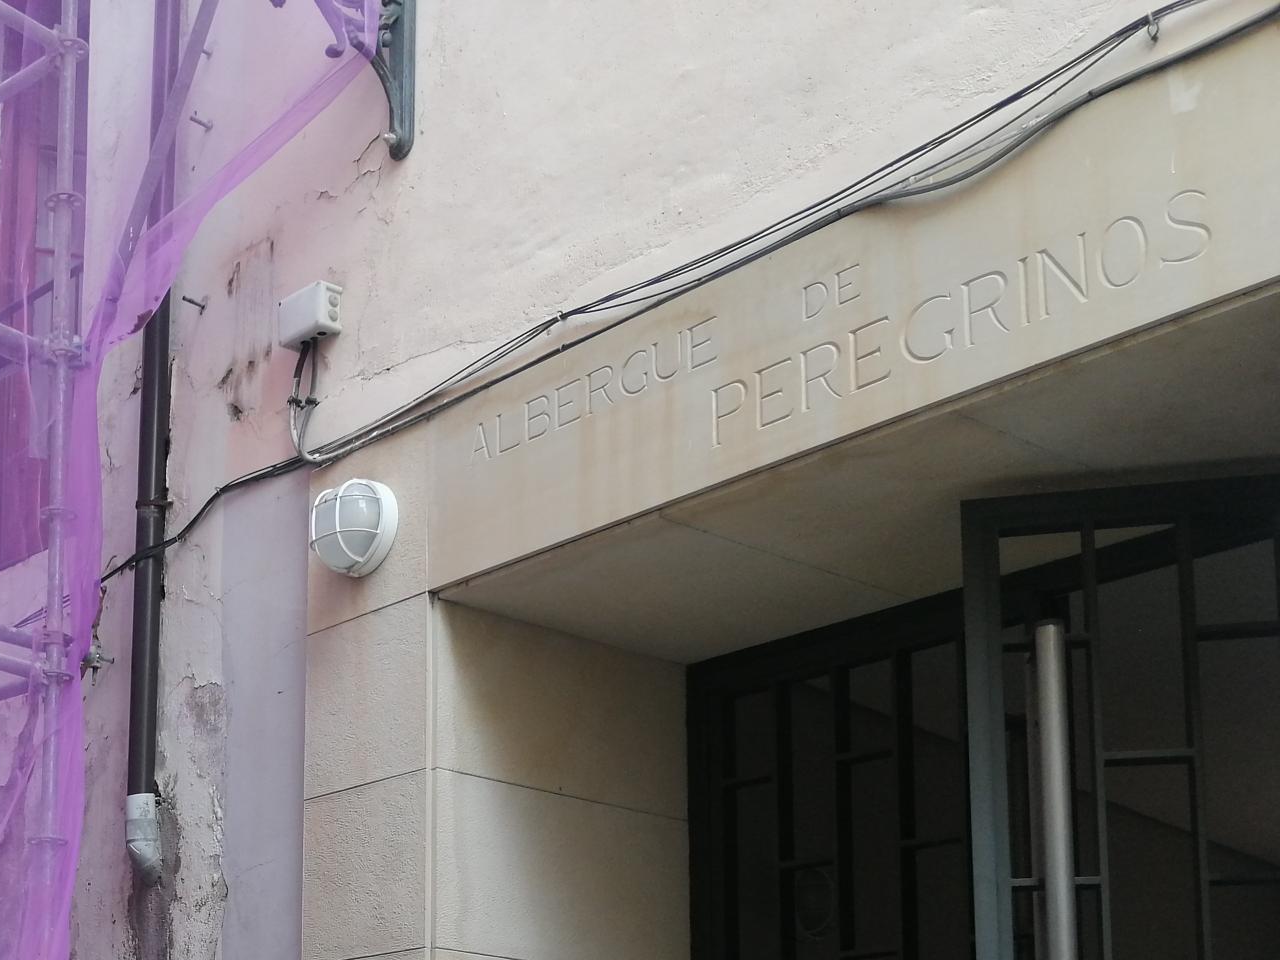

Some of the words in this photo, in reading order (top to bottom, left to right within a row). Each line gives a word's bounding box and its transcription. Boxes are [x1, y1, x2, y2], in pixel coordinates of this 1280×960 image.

[470, 316, 719, 462] ALBERGUE
[802, 263, 862, 321] DE
[711, 190, 1213, 448] PEREGRINOS
